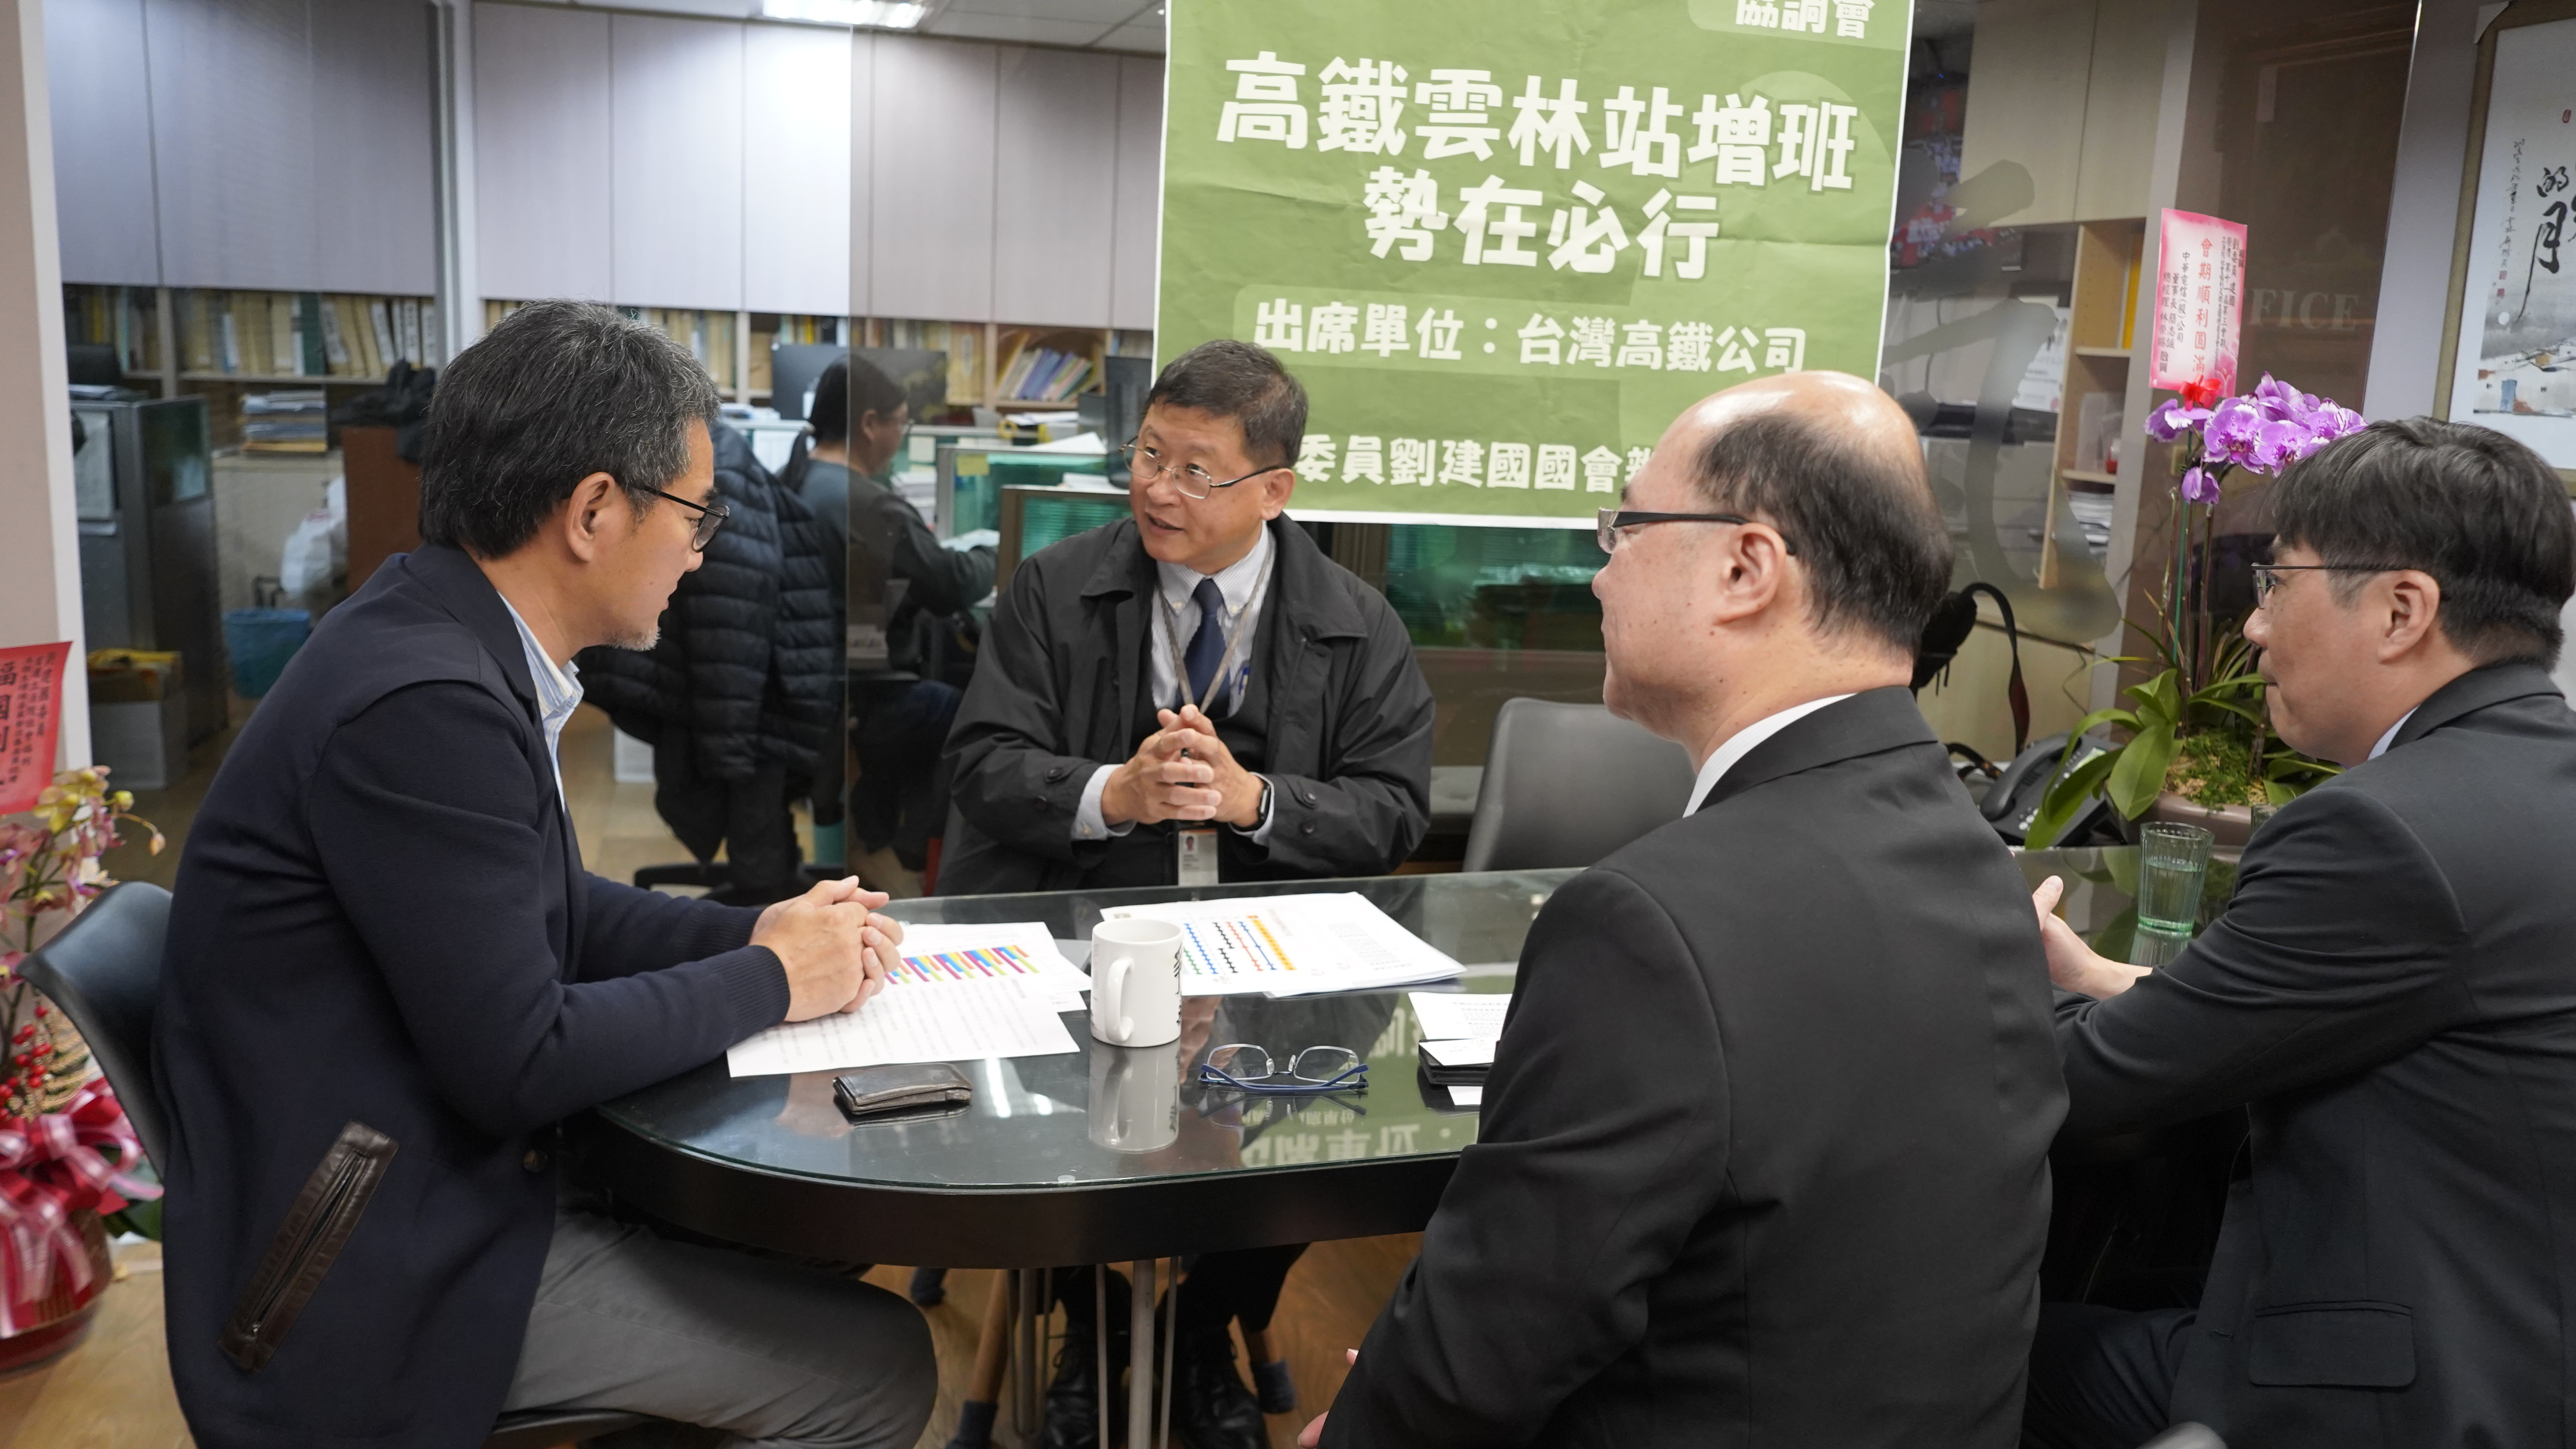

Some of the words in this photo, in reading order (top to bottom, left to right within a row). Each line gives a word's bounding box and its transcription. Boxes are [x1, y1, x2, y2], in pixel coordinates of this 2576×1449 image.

[1216, 51, 1858, 192] 高鐵雲林站增班
[1364, 165, 1720, 280] 勢在必行
[1254, 298, 1807, 374] 出席單位：台灣高鐵公司
[2192, 237, 2213, 373] 會期順利圓滿
[2245, 288, 2359, 331] FICE
